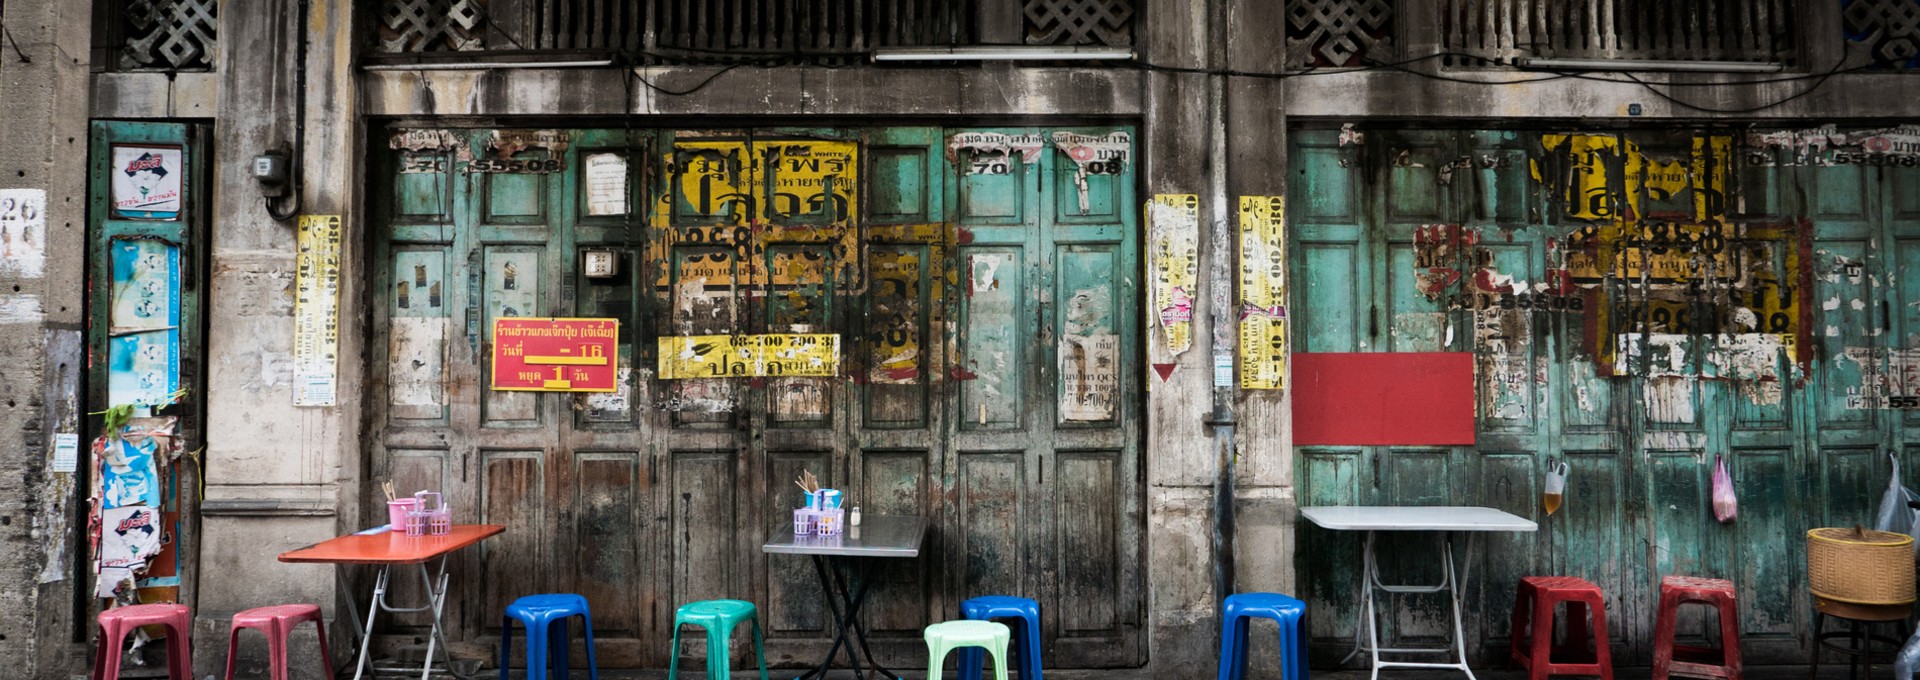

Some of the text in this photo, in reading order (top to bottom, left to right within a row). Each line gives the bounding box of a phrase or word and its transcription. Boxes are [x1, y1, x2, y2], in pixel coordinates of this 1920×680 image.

[128, 153, 163, 172] มะลิ
[501, 341, 524, 356] วันที่
[580, 345, 603, 358] 16
[518, 366, 589, 384] หยุด 1 วัน
[118, 511, 151, 532] มะลิ
